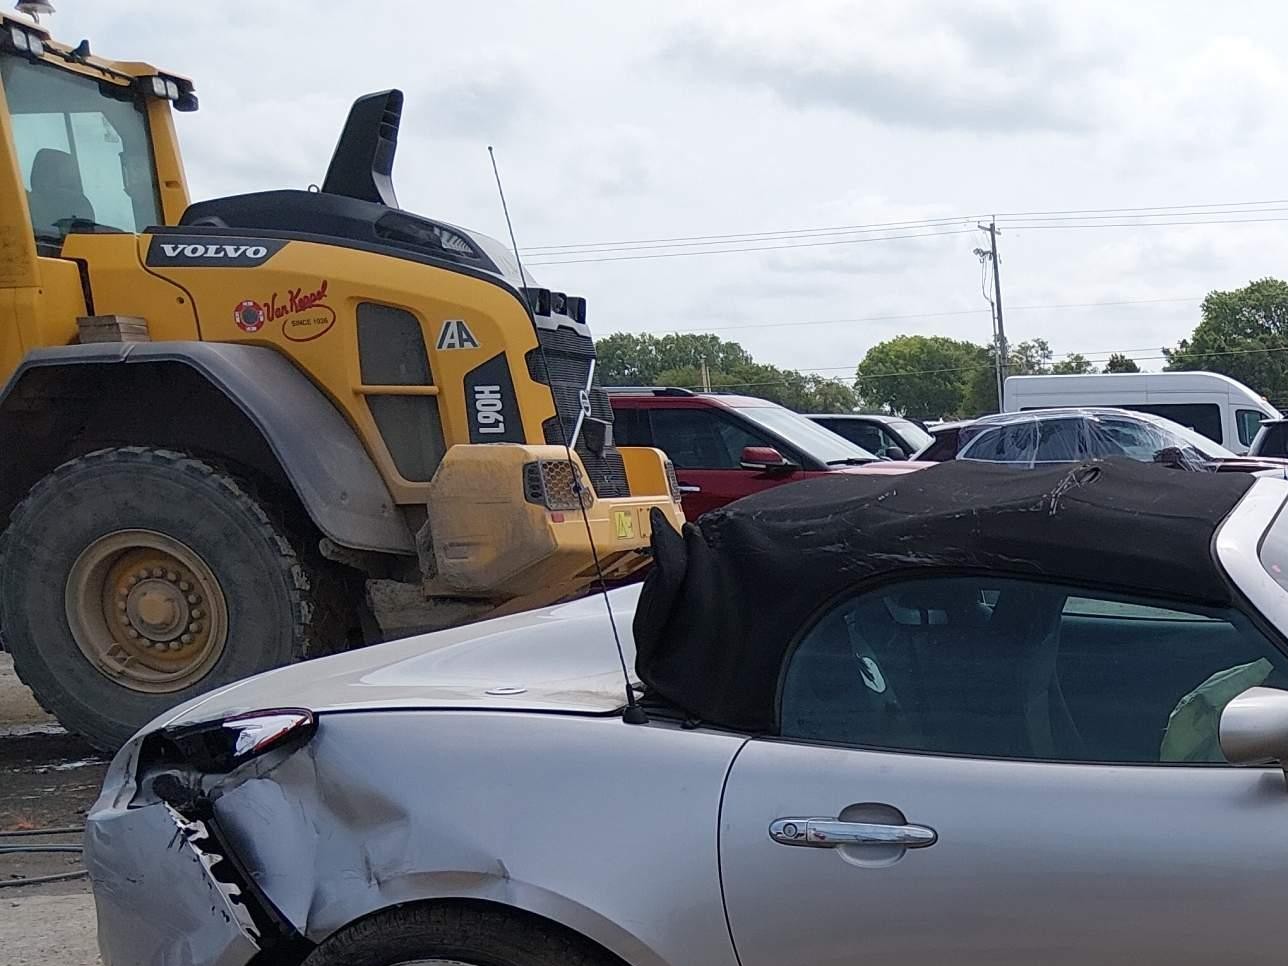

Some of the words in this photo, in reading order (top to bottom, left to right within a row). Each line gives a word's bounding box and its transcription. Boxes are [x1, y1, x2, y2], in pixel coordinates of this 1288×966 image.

[160, 244, 267, 258] VOLVO
[263, 292, 289, 321] Van
[291, 318, 312, 327] SINCE
[474, 385, 505, 433] L90H
